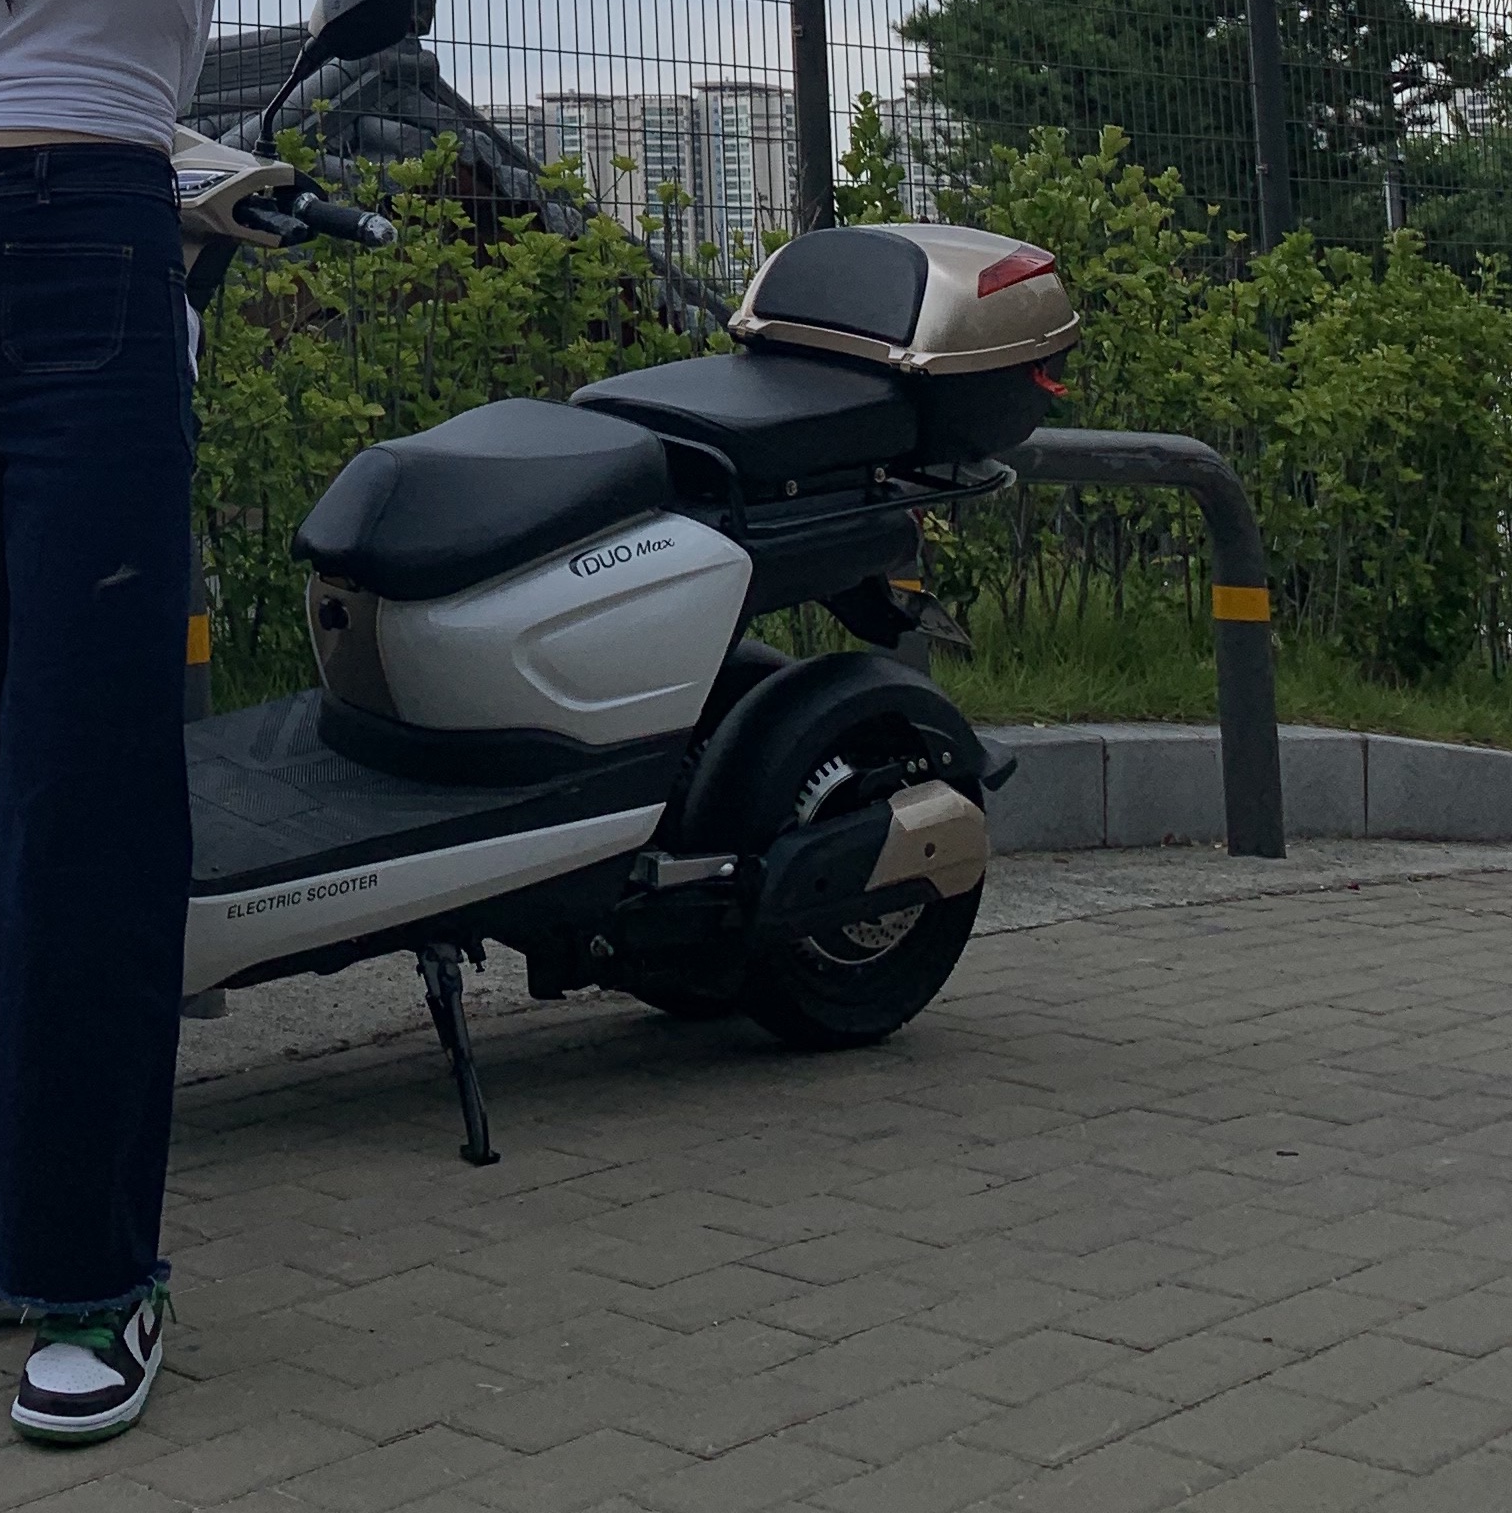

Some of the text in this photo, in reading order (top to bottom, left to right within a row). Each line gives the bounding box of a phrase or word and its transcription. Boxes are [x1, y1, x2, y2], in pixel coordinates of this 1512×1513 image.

[581, 537, 676, 576] DUO Max
[226, 873, 379, 920] ELECTRIC SCOOTER
